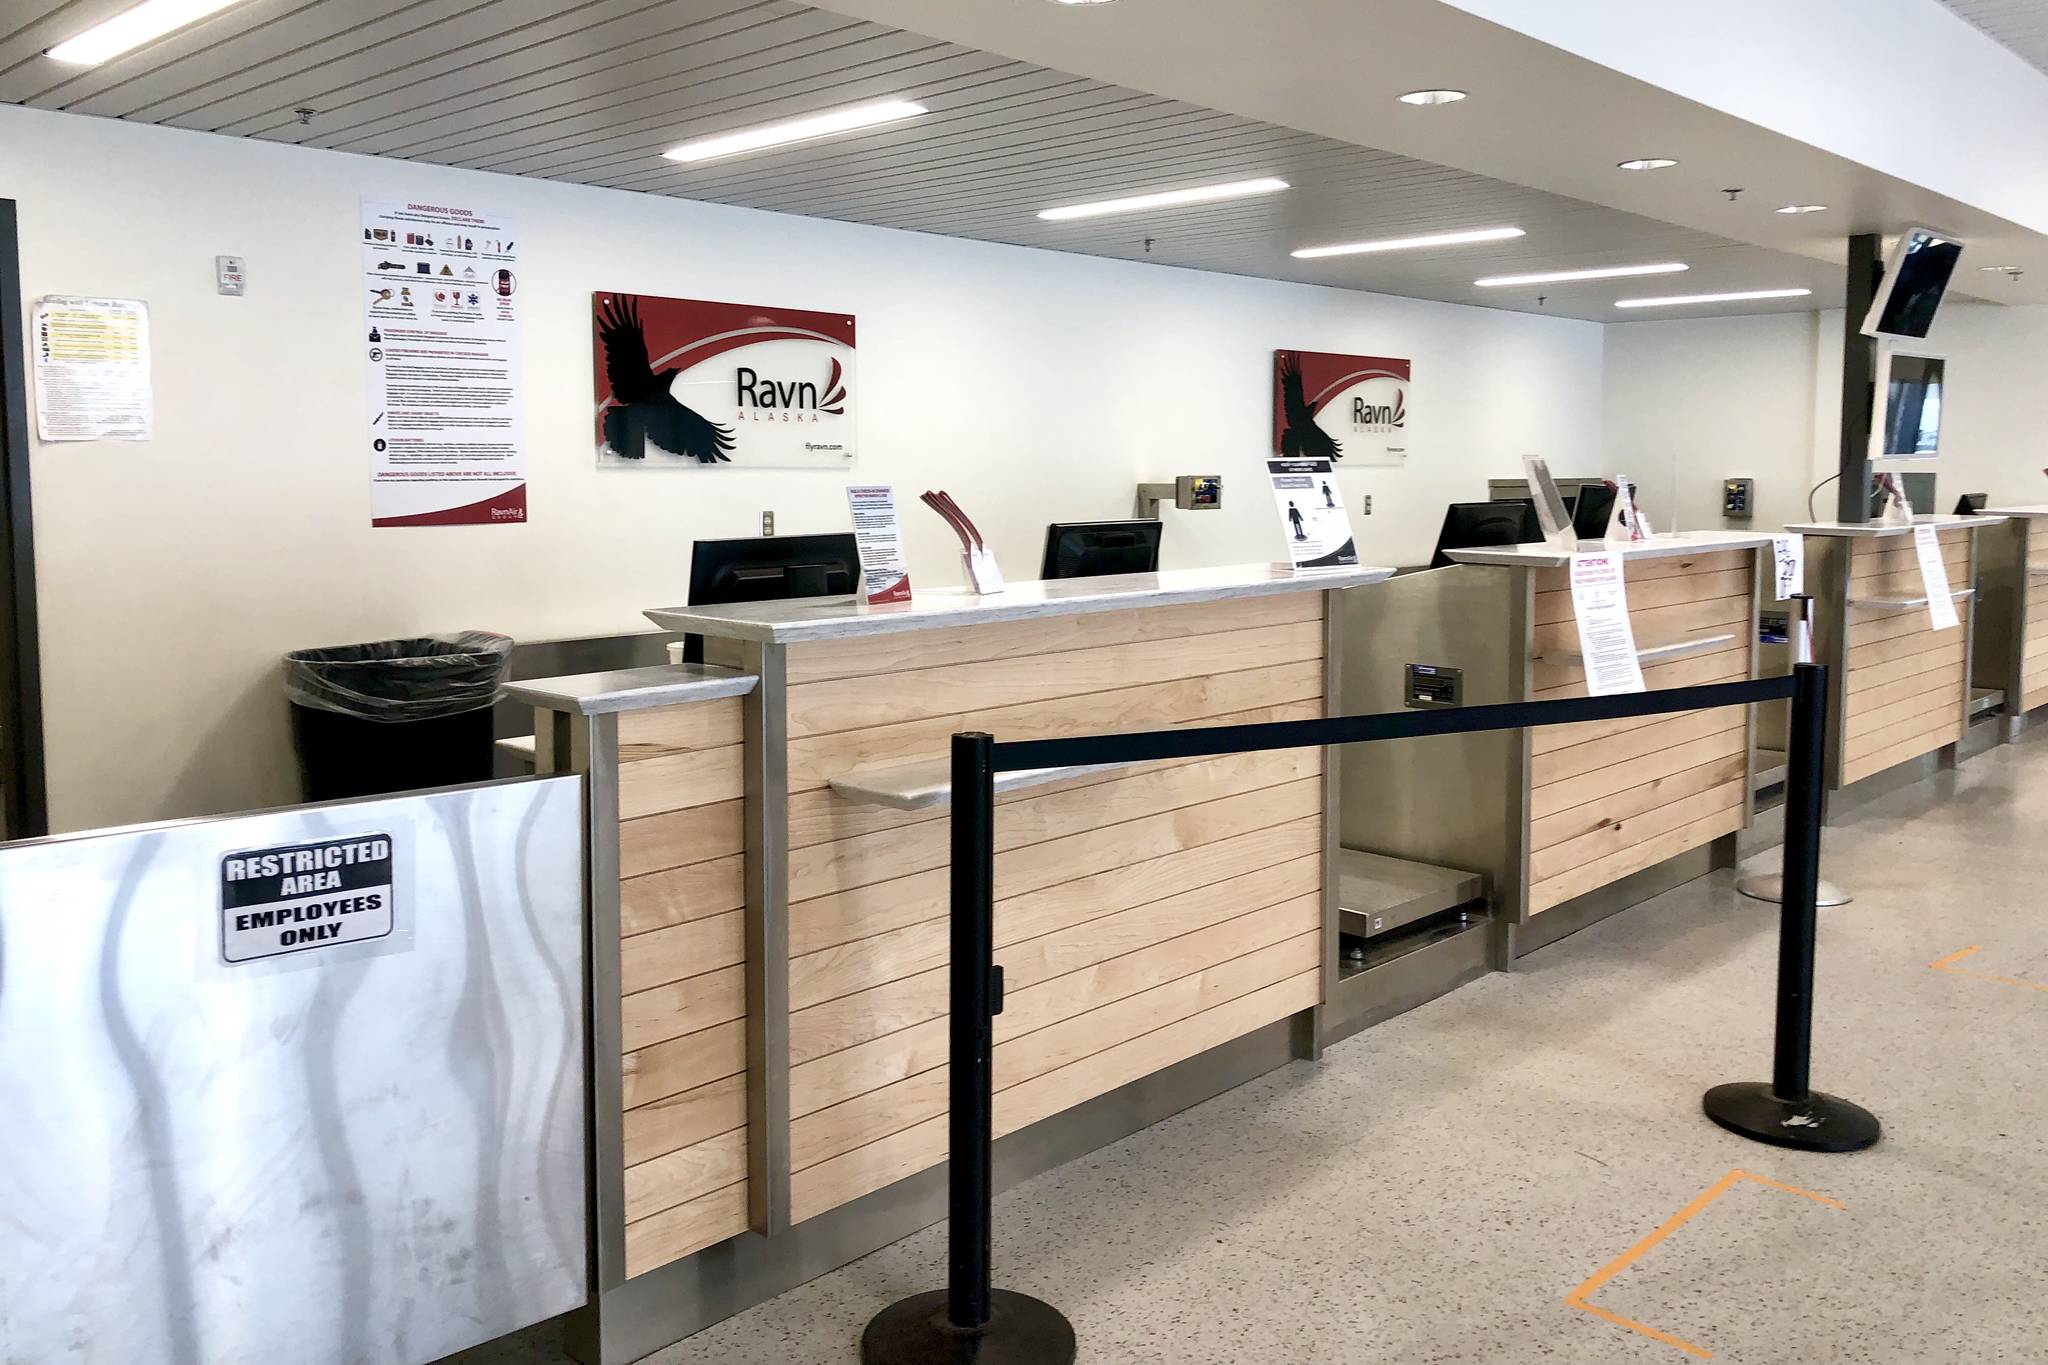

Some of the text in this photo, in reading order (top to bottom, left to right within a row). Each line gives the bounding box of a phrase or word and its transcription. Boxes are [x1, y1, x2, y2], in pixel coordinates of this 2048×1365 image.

[407, 203, 473, 217] DANGEROUS GOODS
[737, 367, 818, 411] Ravn
[738, 411, 819, 424] ALASKA
[1354, 396, 1392, 425] Ravn
[805, 442, 844, 453] flyravn.com
[225, 839, 390, 883] RESTRICTED
[280, 869, 343, 897] AREA
[235, 893, 383, 932] EMPLOYEES
[280, 921, 344, 947] ONLY
